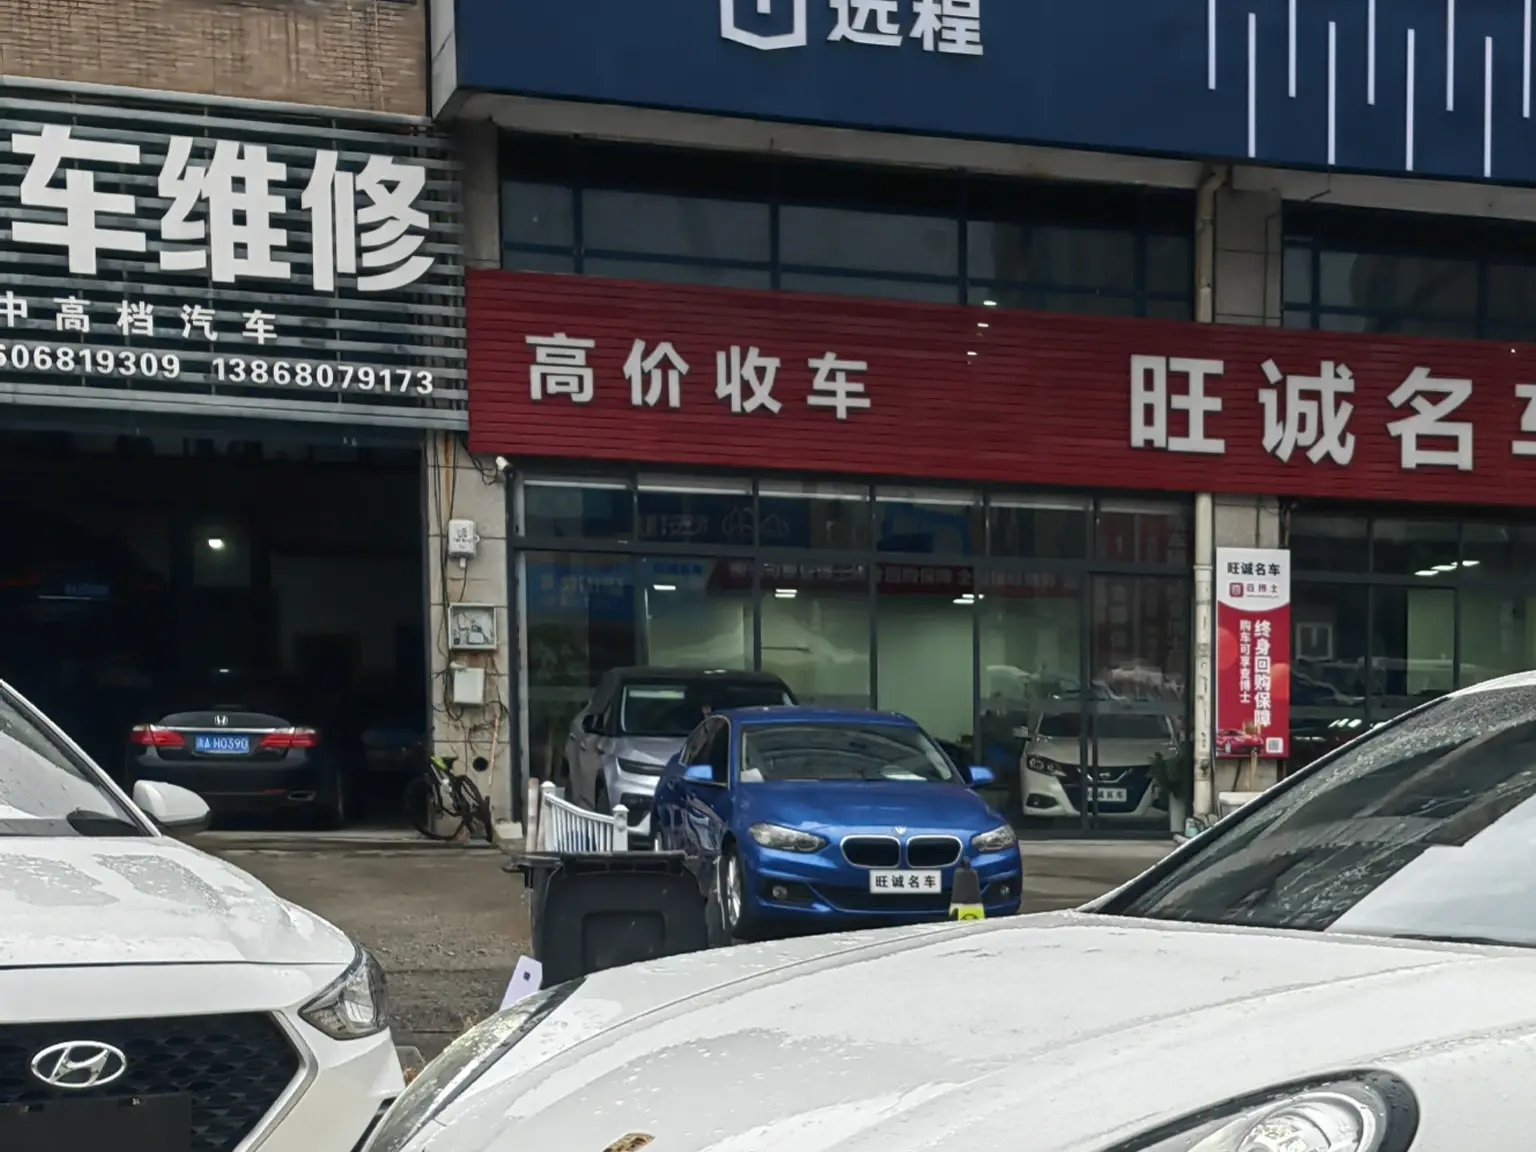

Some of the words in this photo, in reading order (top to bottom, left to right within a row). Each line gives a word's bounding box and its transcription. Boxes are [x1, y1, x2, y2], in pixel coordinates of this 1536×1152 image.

[826, 0, 983, 55] 远程
[12, 124, 436, 291] 车维修
[0, 290, 277, 345] 中高档汽车
[212, 357, 434, 395] 13868079173
[525, 332, 871, 420] 高价收车
[1227, 562, 1280, 576] 旺诚名车
[875, 875, 939, 889] 旺诚名车
